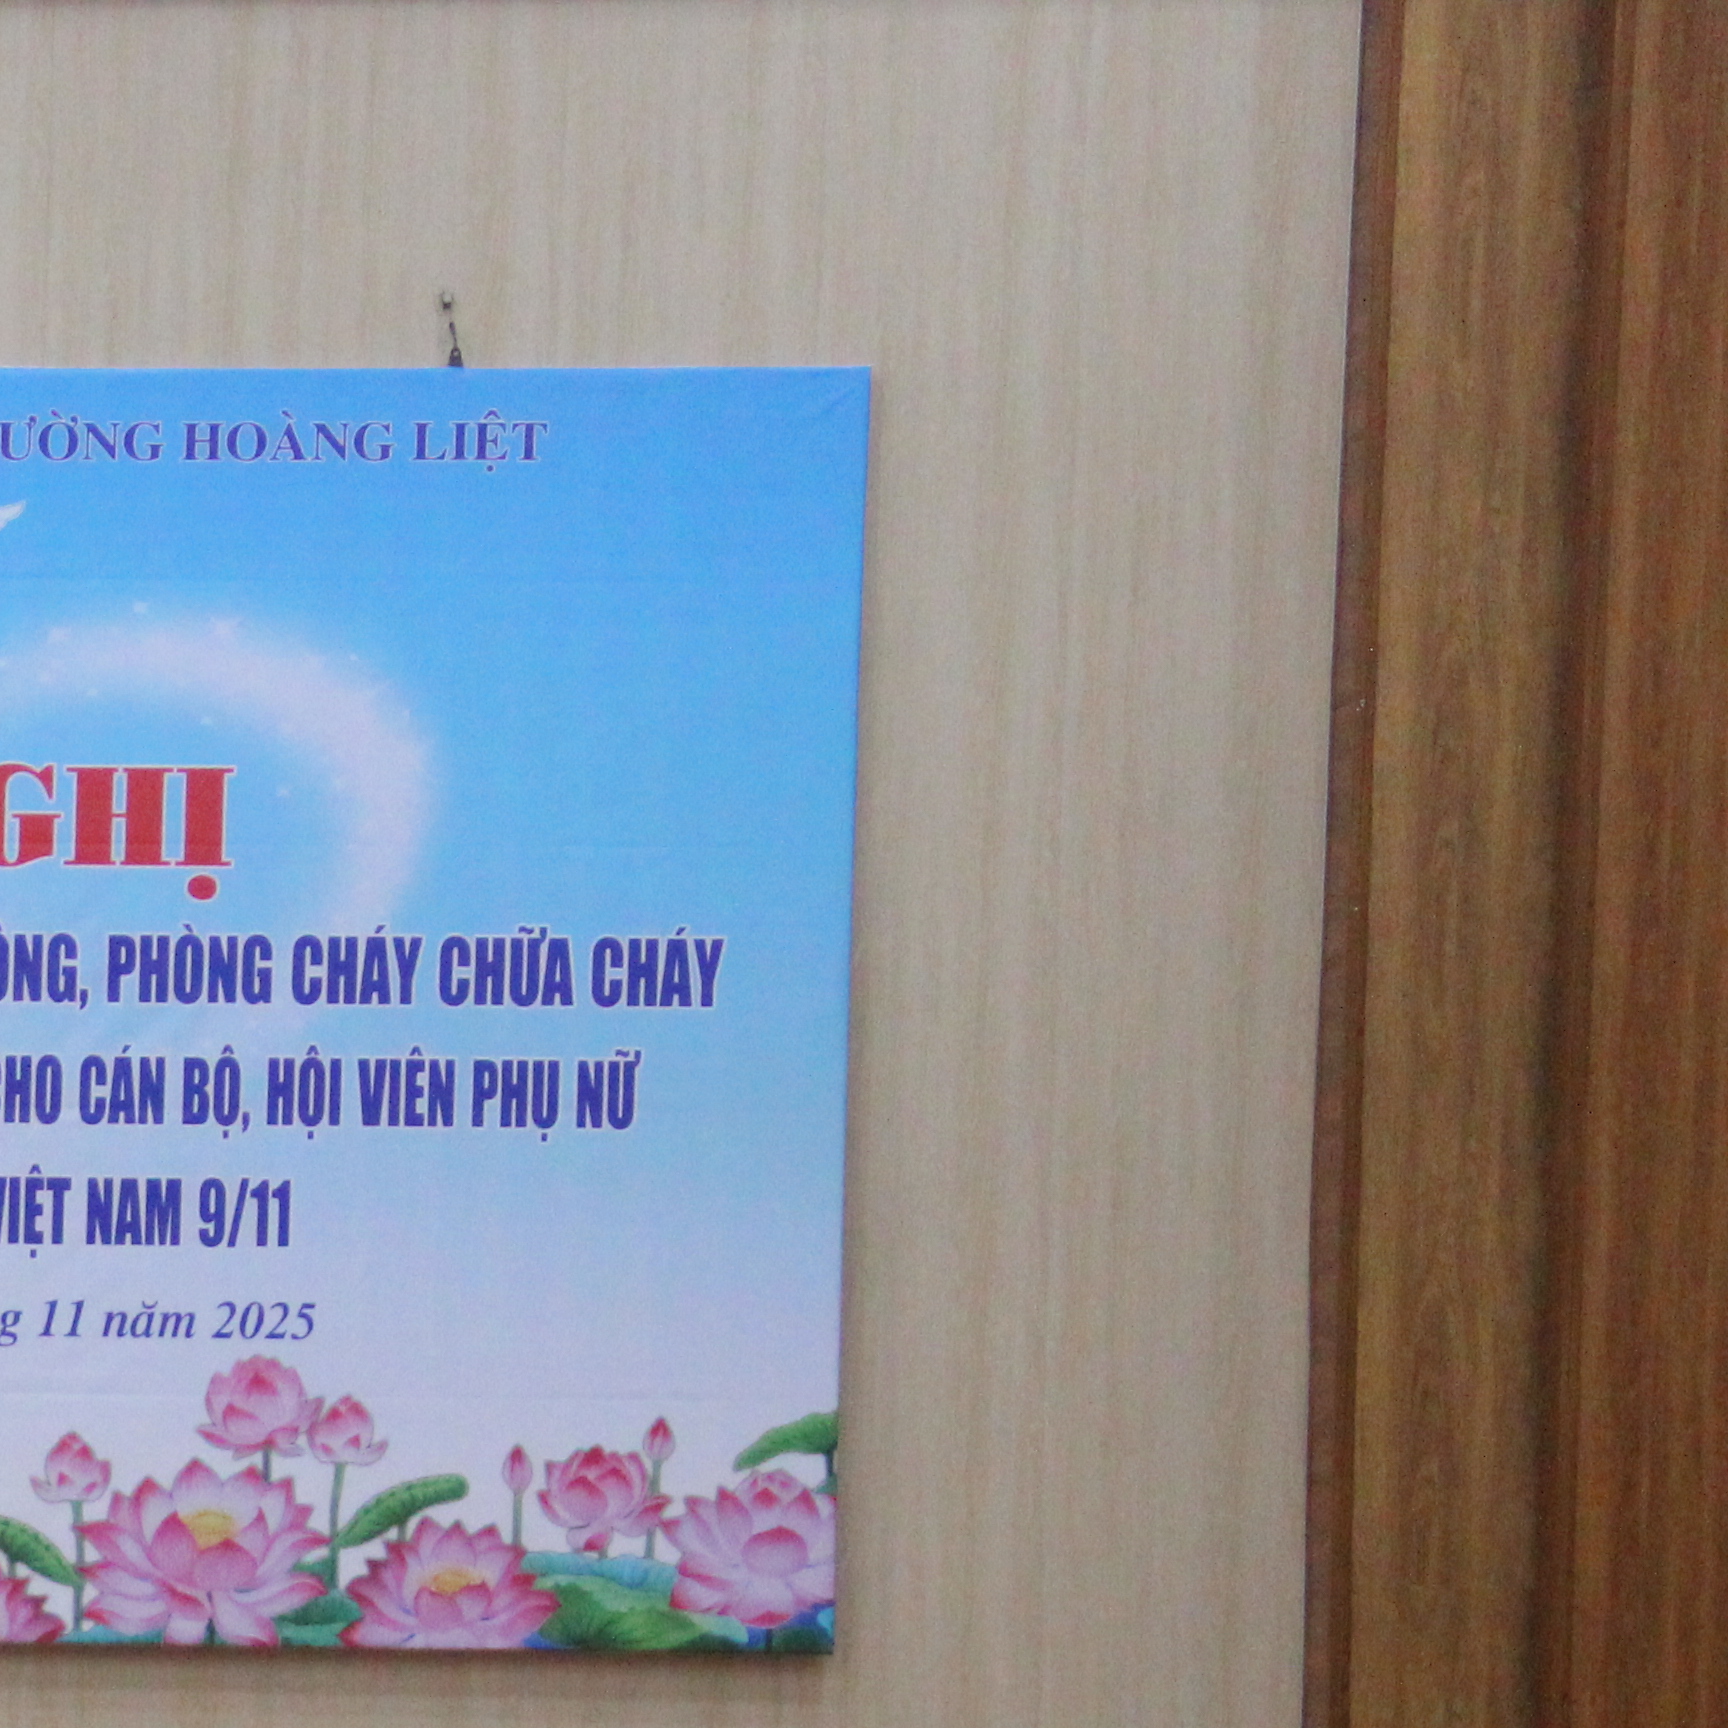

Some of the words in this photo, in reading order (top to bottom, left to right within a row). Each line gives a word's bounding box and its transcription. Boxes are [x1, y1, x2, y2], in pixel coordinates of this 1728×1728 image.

[183, 410, 393, 461] HOÀNG
[413, 410, 547, 472] LIỆT
[107, 924, 272, 1005] PHÒNG
[292, 925, 422, 1005] CHÁY
[439, 926, 574, 1007] CHỮA
[591, 927, 724, 1008] CHÁY
[79, 1045, 165, 1125] CÁN
[182, 1045, 251, 1139] BỘ,
[267, 1045, 341, 1139] HỘI
[358, 1046, 455, 1127] VIÊN
[472, 1060, 559, 1142] PHỤ
[576, 1050, 641, 1130] NỮ
[86, 1178, 182, 1246] NAM
[199, 1178, 290, 1247] 9/11
[39, 1300, 84, 1336] 11
[103, 1301, 195, 1338] năm
[212, 1302, 315, 1340] 2025
